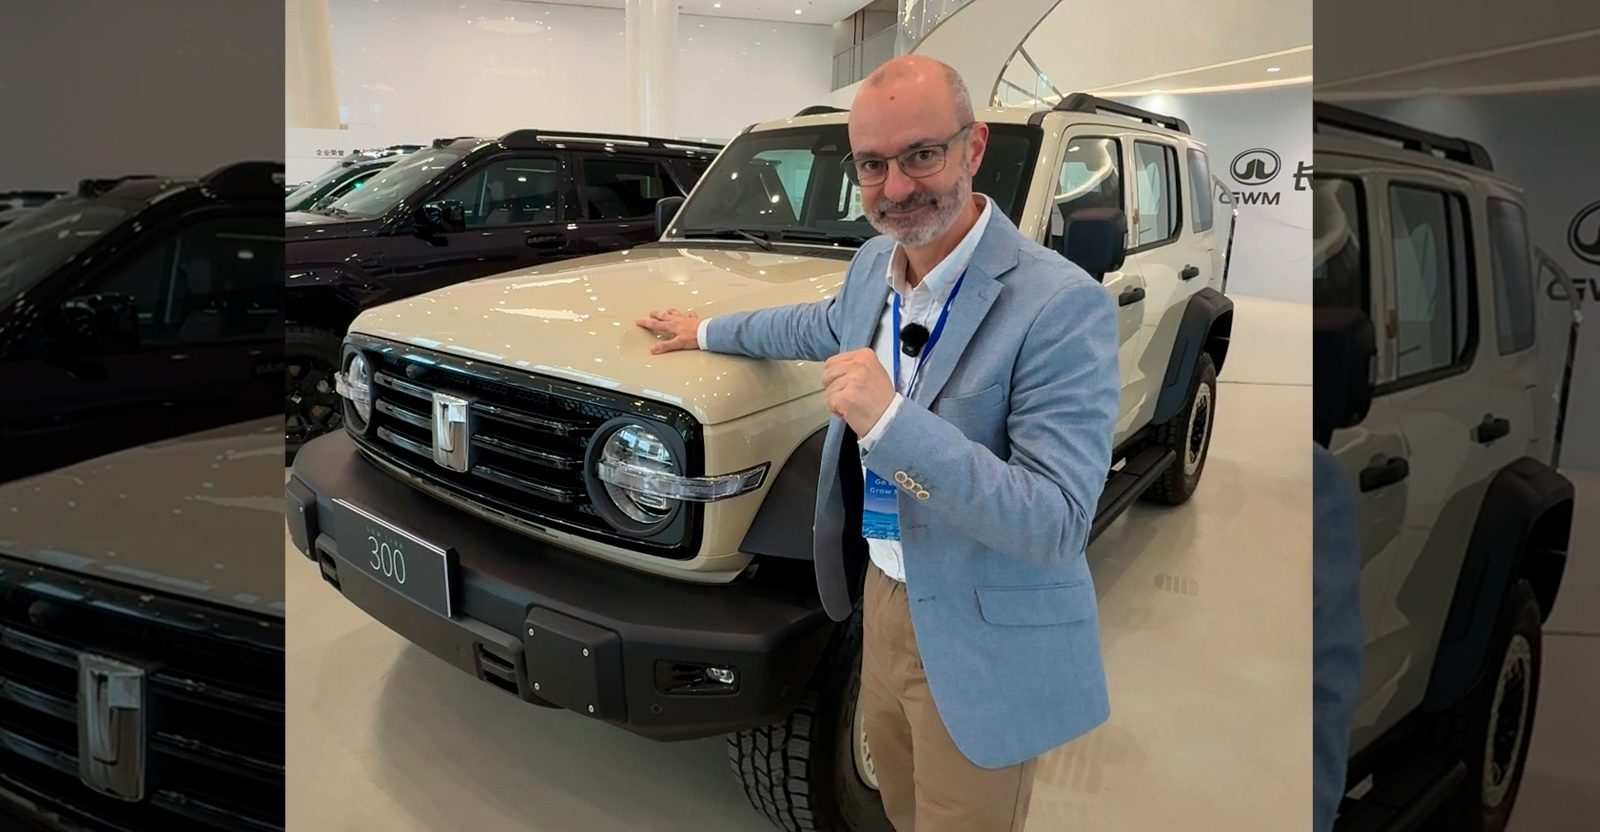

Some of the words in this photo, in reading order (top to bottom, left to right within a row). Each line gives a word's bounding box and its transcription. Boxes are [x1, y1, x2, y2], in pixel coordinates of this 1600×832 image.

[1219, 192, 1280, 205] GWM
[875, 478, 887, 486] Go
[869, 487, 892, 495] Grow
[368, 536, 406, 584] 300
